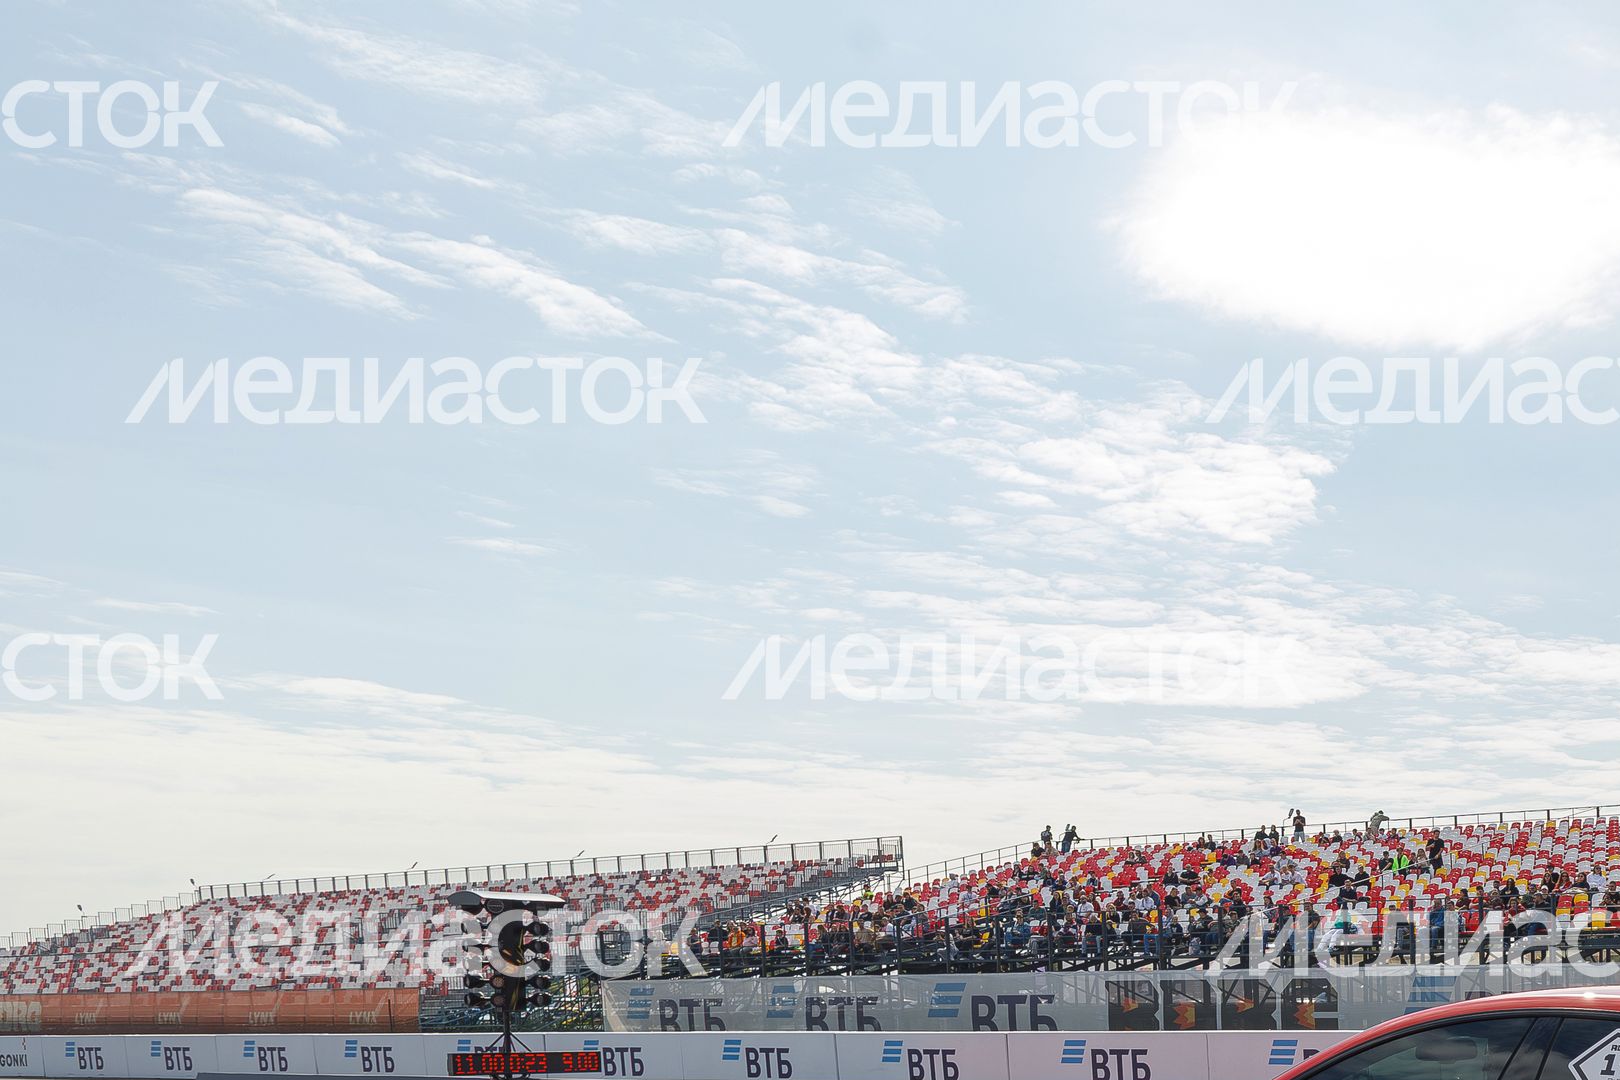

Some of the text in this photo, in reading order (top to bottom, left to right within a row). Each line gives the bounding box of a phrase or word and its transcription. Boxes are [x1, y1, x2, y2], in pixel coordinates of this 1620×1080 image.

[660, 998, 726, 1031] ВТБ
[805, 996, 882, 1031] ВТБ
[971, 994, 1058, 1031] ВТБ
[77, 1047, 104, 1070] ВТБ
[164, 1046, 192, 1071] ВТБ
[257, 1046, 288, 1072] ВТБ
[360, 1046, 395, 1073] ВТБ
[602, 1047, 645, 1077] ВТБ
[745, 1047, 793, 1079] ВТБ
